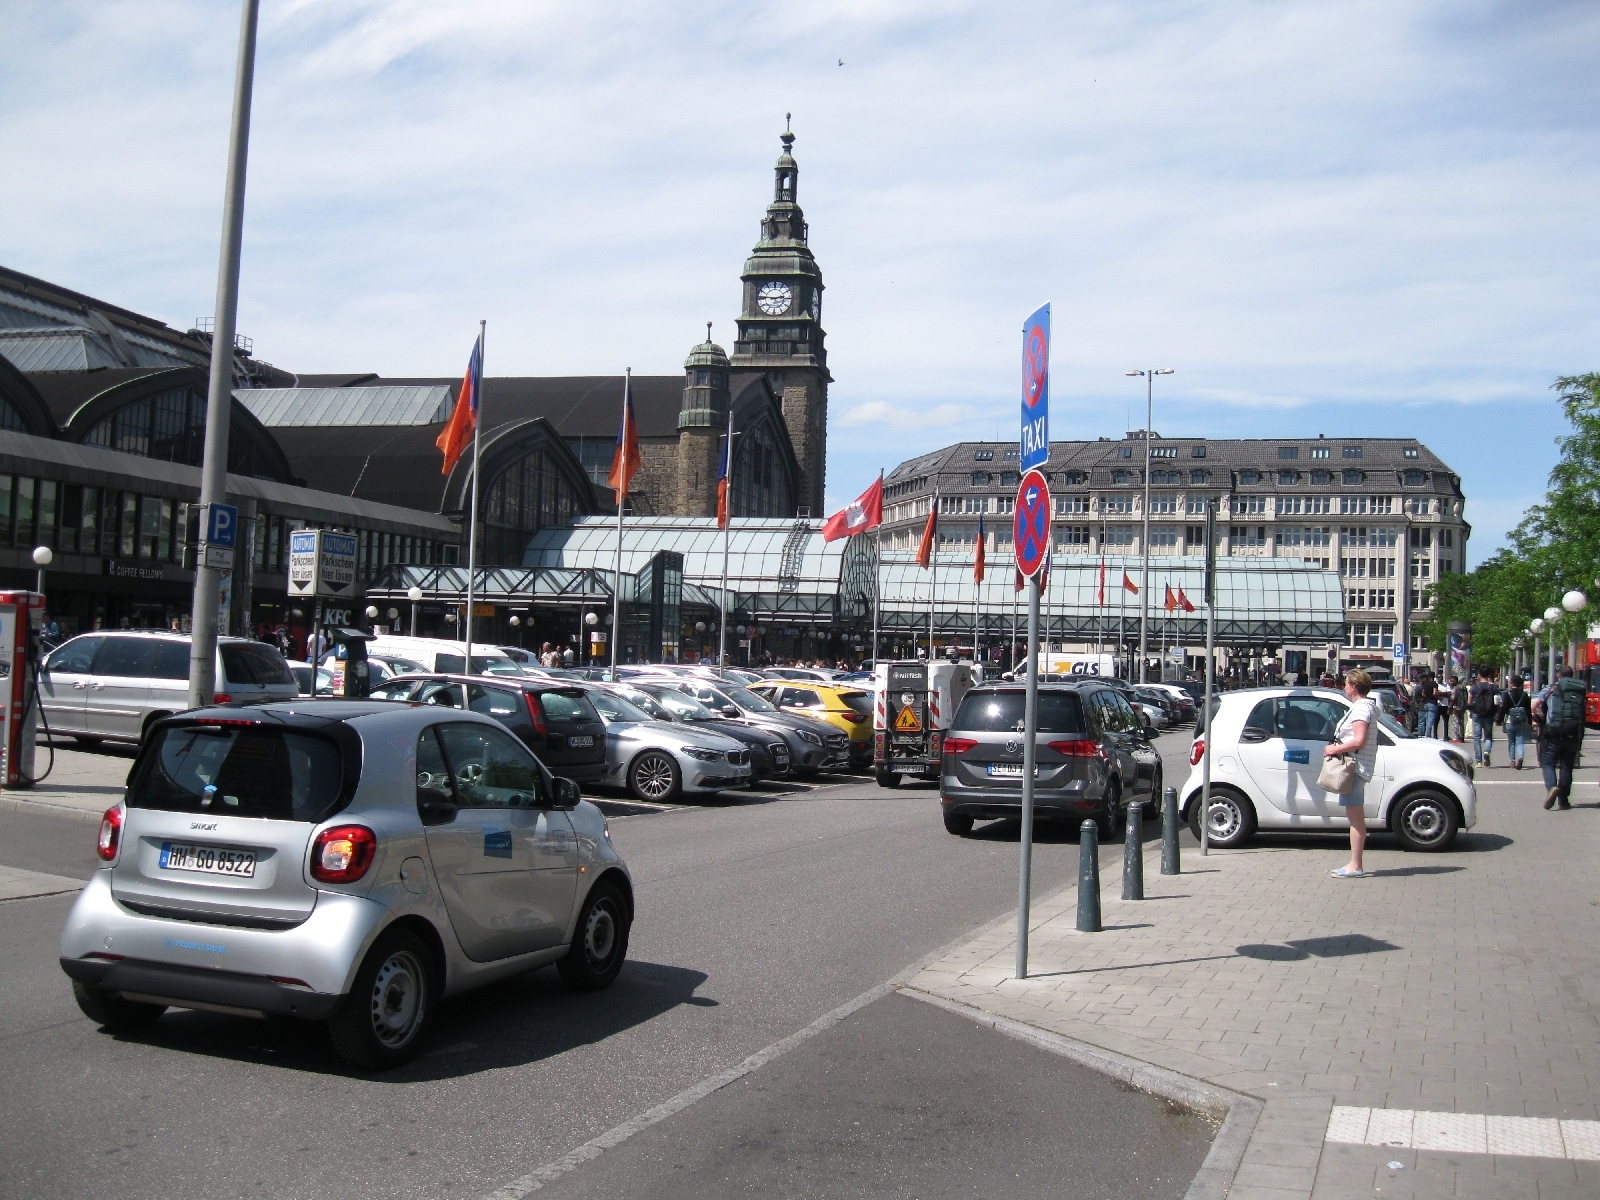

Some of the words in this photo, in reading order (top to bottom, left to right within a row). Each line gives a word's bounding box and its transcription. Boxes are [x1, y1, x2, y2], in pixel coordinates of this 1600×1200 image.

[1022, 415, 1045, 457] TAXI
[213, 509, 231, 540] P
[293, 536, 316, 552] AUTOMAT
[323, 537, 355, 554] AUTOMAT
[321, 554, 354, 569] Parkschein
[116, 566, 138, 577] COFFEE
[321, 567, 334, 580] hier
[336, 569, 353, 582] lösen
[323, 607, 351, 626] KFC
[1071, 662, 1099, 676] GLS
[169, 846, 188, 867] HH
[196, 848, 215, 870] GO
[217, 851, 254, 874] 8522
